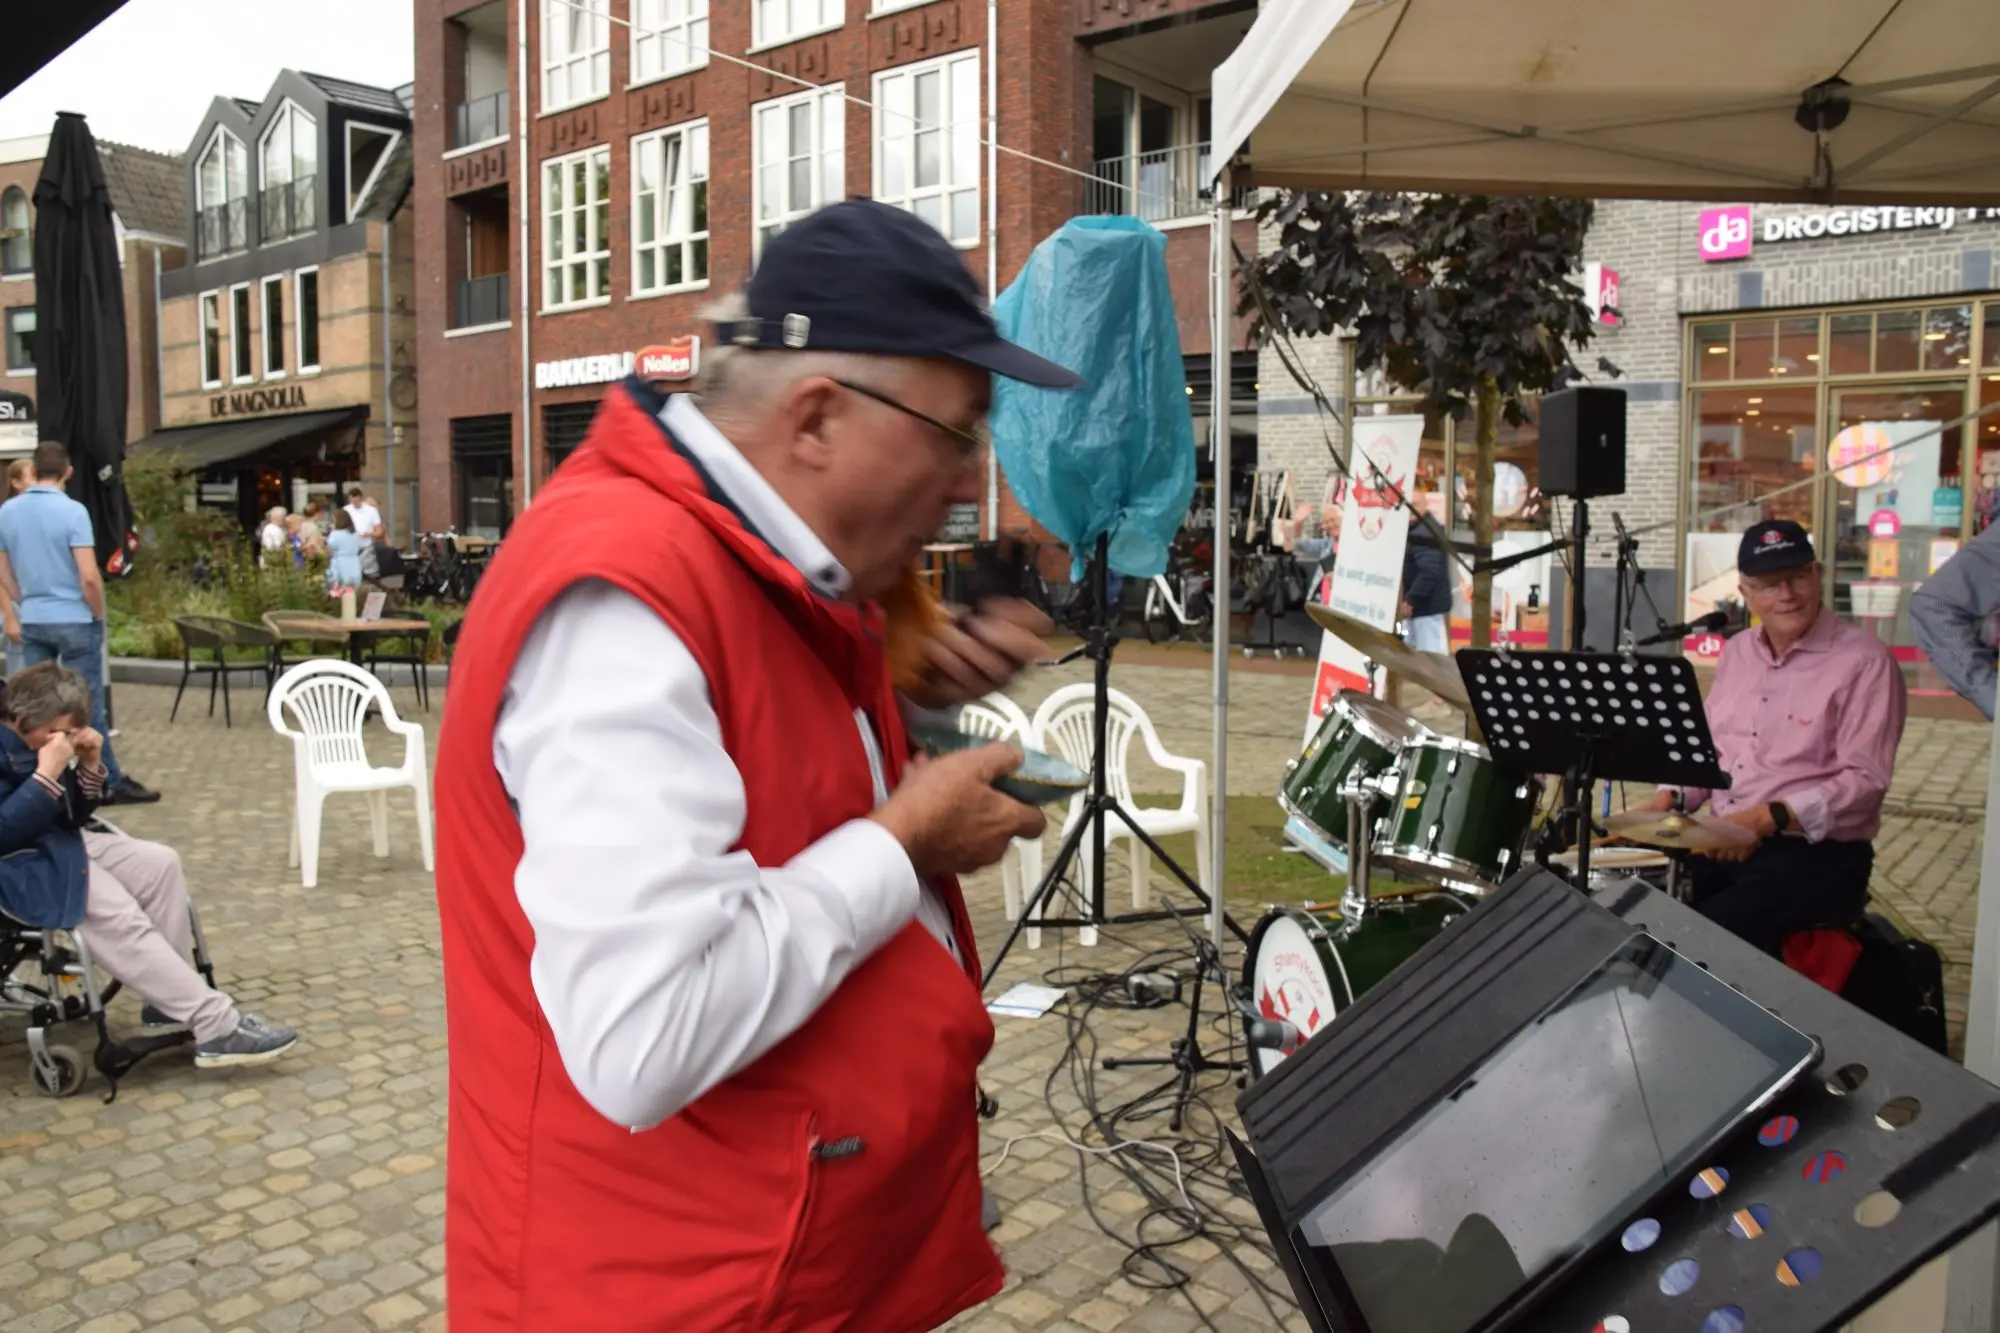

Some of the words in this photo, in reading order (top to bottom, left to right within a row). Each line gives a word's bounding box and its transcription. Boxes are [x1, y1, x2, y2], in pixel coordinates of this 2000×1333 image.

[1702, 214, 1747, 253] da
[1763, 206, 1955, 242] DROGISTERIJ
[535, 351, 634, 389] BAKKERIJ
[210, 396, 228, 417] DE
[231, 384, 307, 414] MAGNOLIA
[1697, 635, 1721, 656] da
